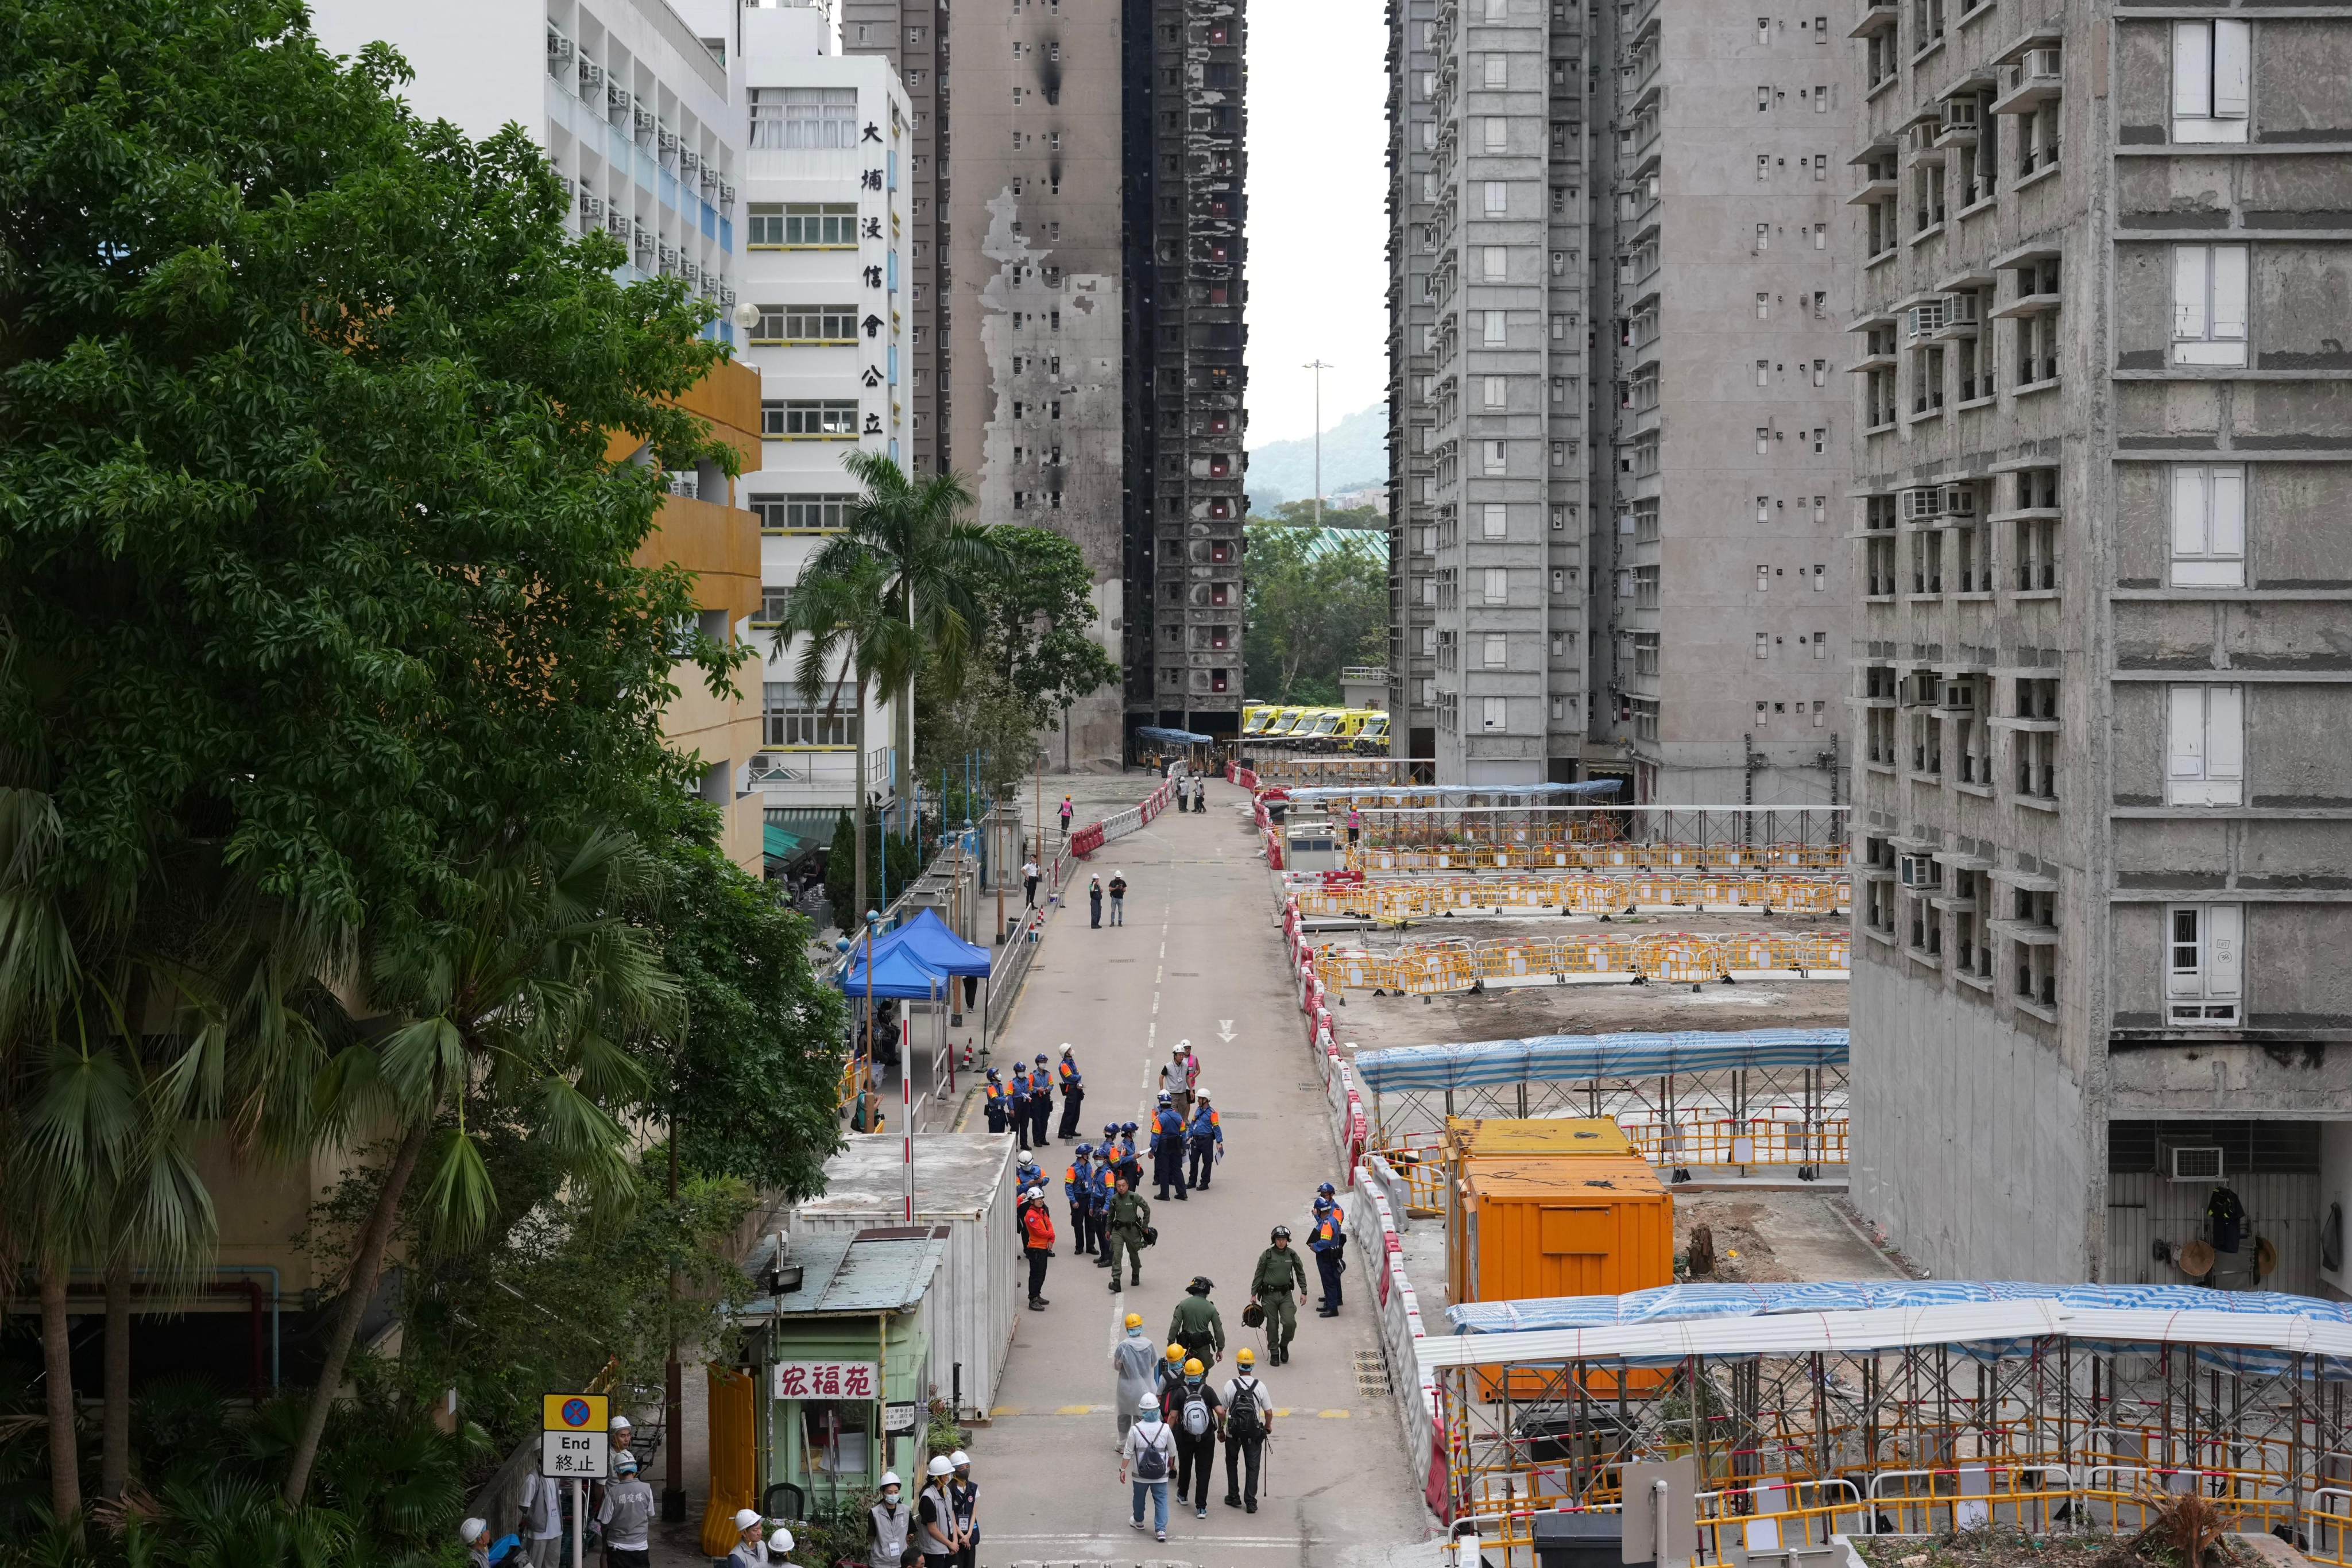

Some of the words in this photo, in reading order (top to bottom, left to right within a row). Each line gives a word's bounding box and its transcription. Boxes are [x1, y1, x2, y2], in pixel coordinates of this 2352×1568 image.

[861, 121, 884, 435] 大埔浸信會公立
[782, 1363, 871, 1396] 宏福苑
[562, 1437, 590, 1450] End
[555, 1454, 595, 1472] 終止
